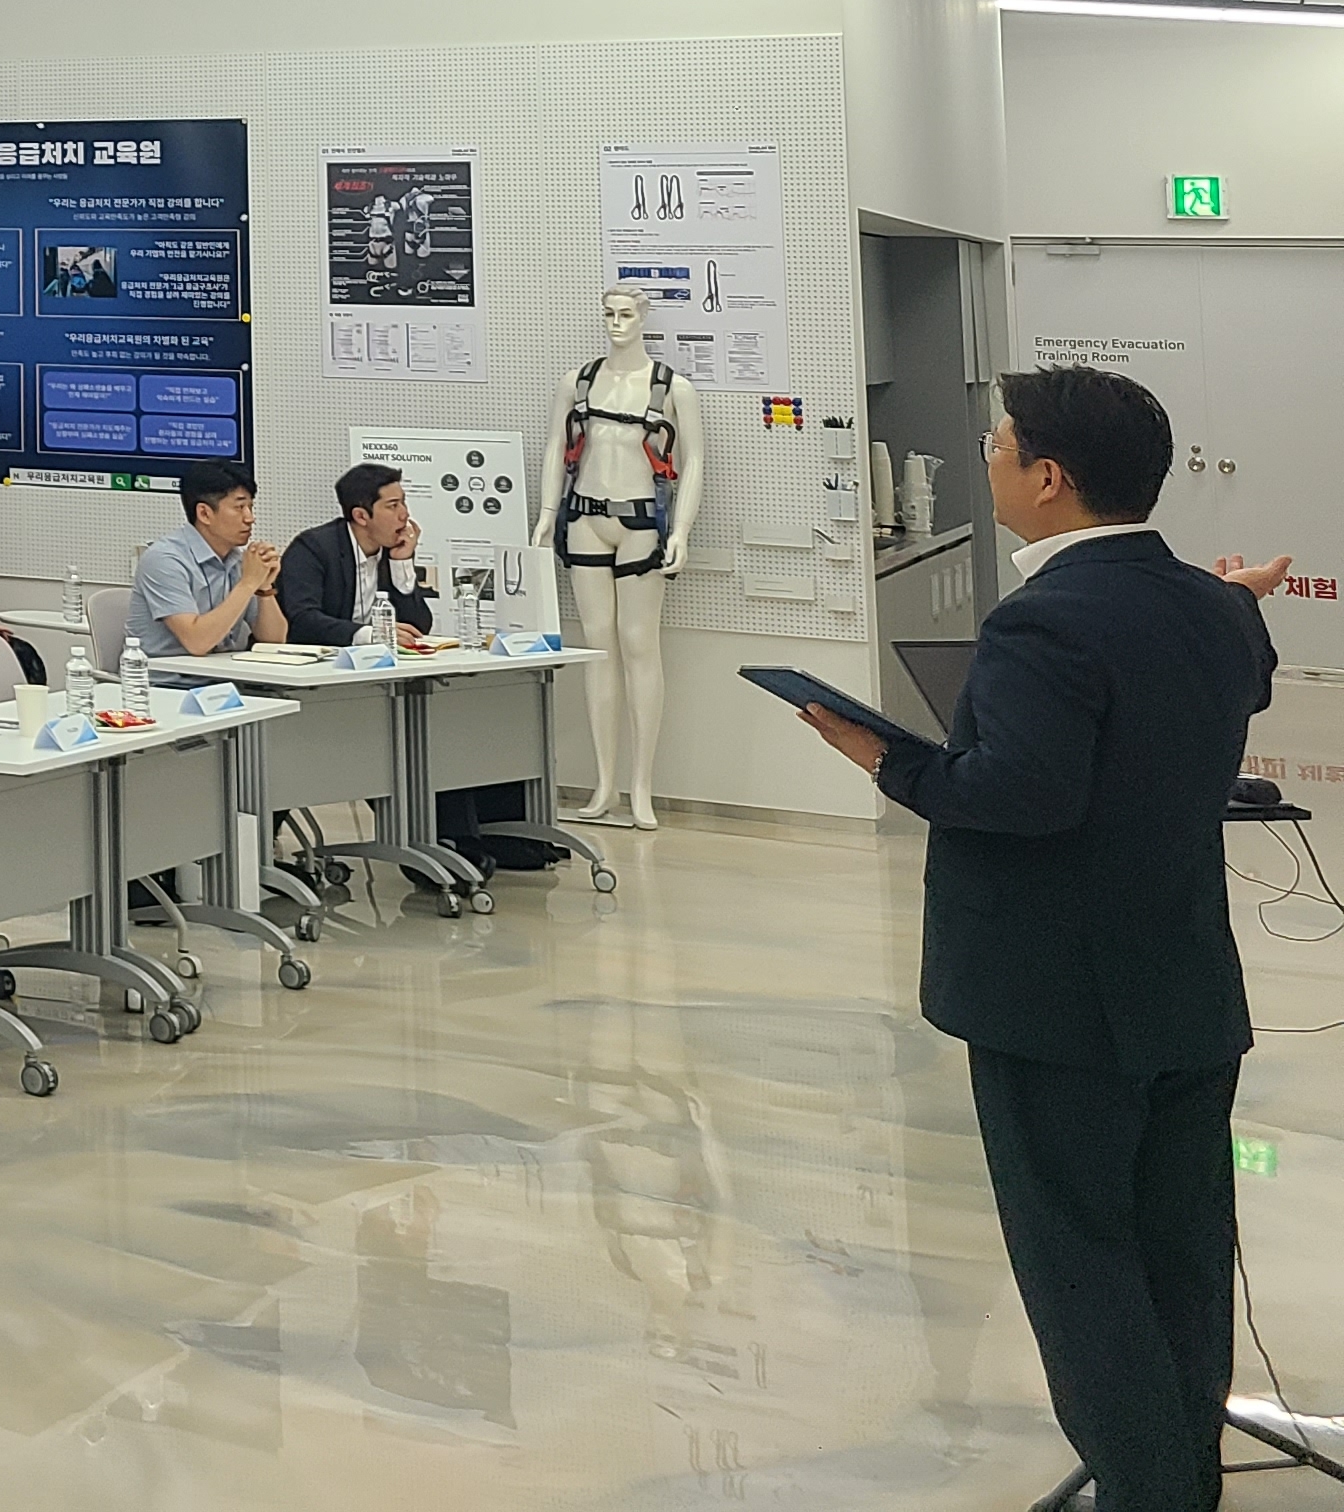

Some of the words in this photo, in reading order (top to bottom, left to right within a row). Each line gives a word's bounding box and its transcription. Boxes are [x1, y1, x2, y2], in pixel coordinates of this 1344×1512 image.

[93, 140, 161, 164] 교육원
[79, 198, 112, 208] 응급처치
[113, 198, 146, 208] 전문가가
[148, 198, 165, 208] 직접
[167, 198, 192, 208] 강의를
[153, 335, 178, 346] 차별화
[181, 336, 190, 346] 된
[1035, 337, 1108, 350] Emergency
[1112, 339, 1185, 350] Evacuation
[1035, 350, 1087, 364] Training
[1091, 352, 1130, 362] Room
[362, 443, 398, 451] NEXX360
[363, 453, 390, 461] SMART
[391, 454, 432, 462] SOLUTION
[27, 471, 105, 485] 우리응급처치교육원
[1285, 575, 1338, 600] 체험
